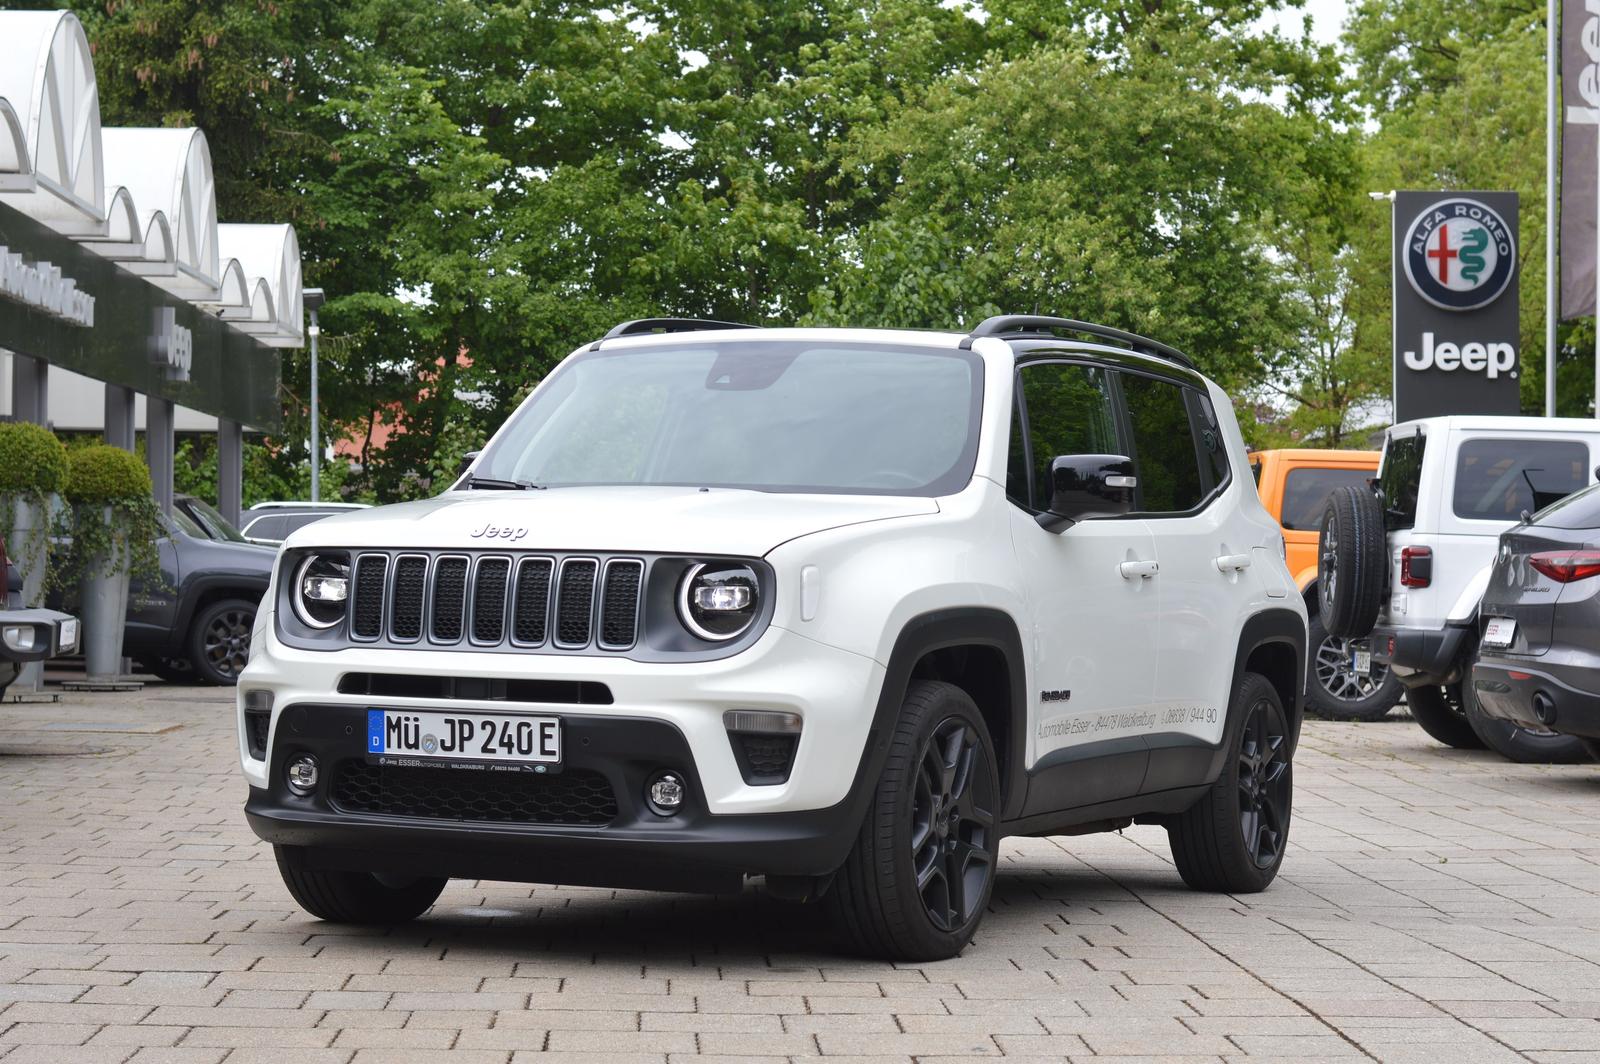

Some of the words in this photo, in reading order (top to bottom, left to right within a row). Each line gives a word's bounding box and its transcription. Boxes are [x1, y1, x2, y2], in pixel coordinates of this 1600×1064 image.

[1412, 212, 1447, 255] ALFA
[1454, 205, 1509, 257] ROMEO
[1404, 332, 1516, 379] Jeep
[470, 523, 529, 542] Jeep
[372, 736, 380, 746] D
[440, 718, 475, 752] JP
[398, 759, 420, 767] ESSER
